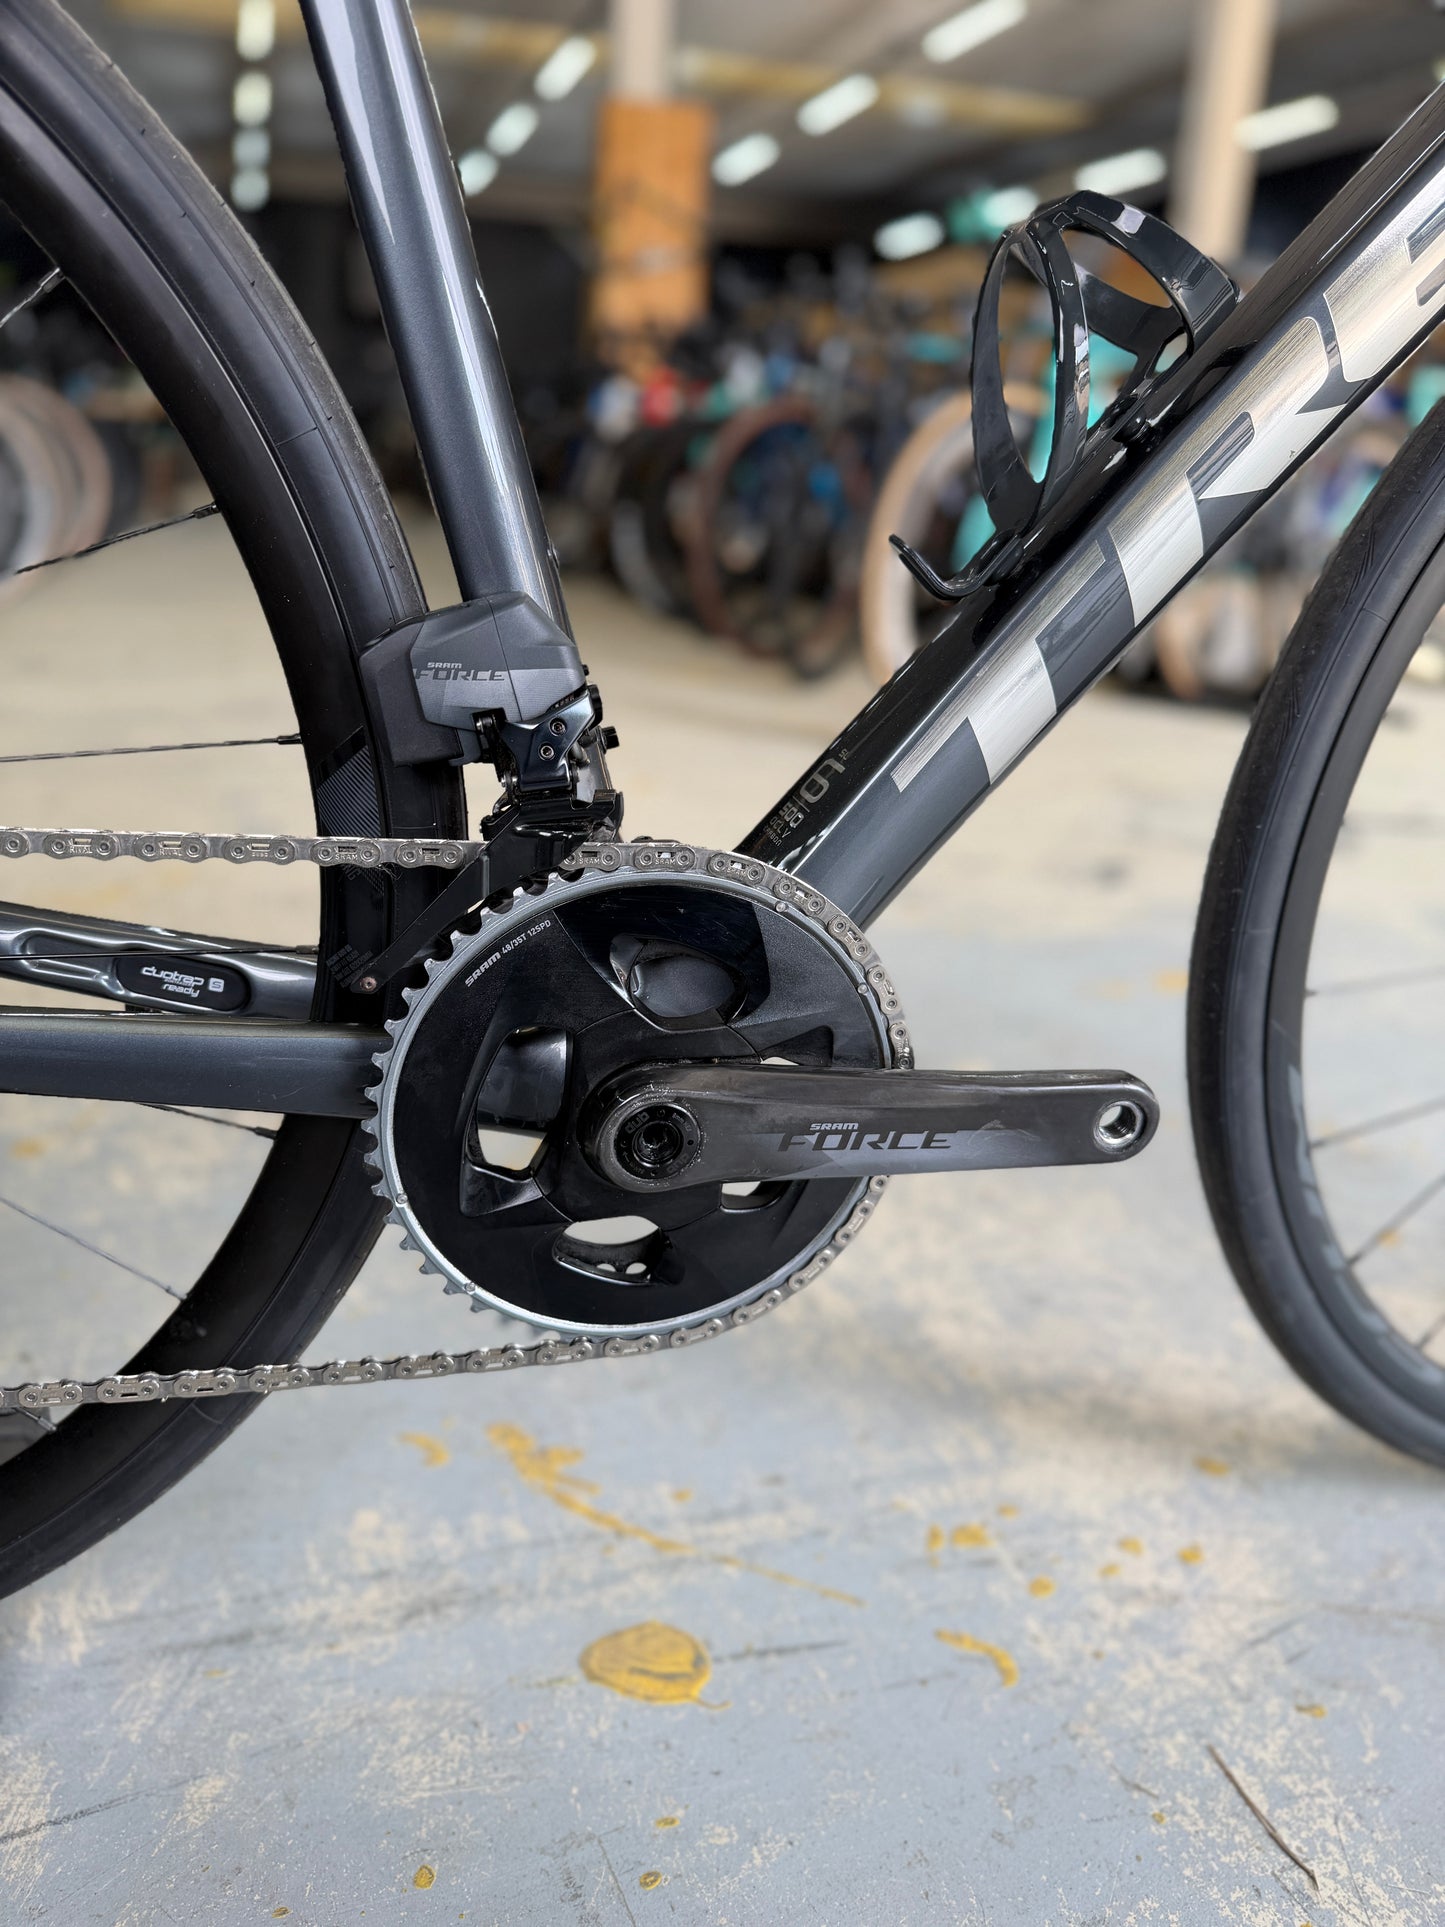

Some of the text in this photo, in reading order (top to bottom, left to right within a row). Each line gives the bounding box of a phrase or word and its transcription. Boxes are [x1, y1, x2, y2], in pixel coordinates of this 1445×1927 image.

[427, 661, 462, 669] SRAM
[414, 667, 505, 682] FORCE
[799, 758, 846, 804] 6
[69, 845, 93, 854] RIVAL
[159, 848, 183, 857] RIVAL
[335, 853, 358, 861] SRAM
[579, 857, 600, 865] SRAM
[465, 919, 551, 988] SRAM 48/35T 12SPD
[142, 966, 205, 988] duotrap
[162, 983, 200, 998] ready
[625, 1111, 650, 1134] dub
[809, 1122, 859, 1131] SRAM
[777, 1130, 952, 1152] FORCE
